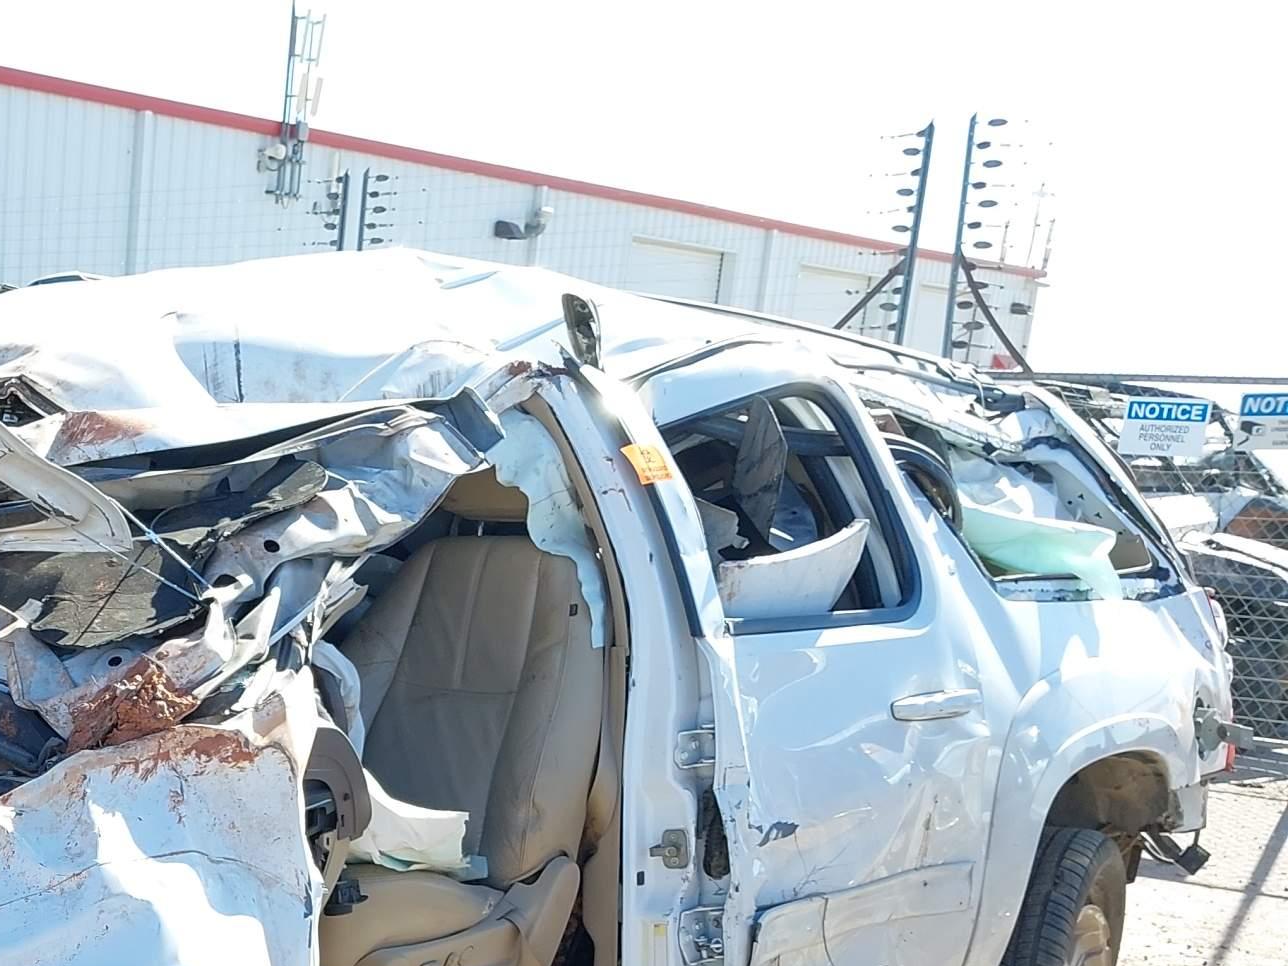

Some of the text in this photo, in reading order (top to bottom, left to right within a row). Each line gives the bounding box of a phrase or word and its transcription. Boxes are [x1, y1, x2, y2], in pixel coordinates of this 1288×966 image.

[1243, 396, 1288, 414] NOT
[1130, 403, 1205, 421] NOTICE
[1139, 424, 1190, 434] AUTHORIZED
[1138, 433, 1185, 443] PERSONNEL
[1149, 443, 1172, 451] ONLY
